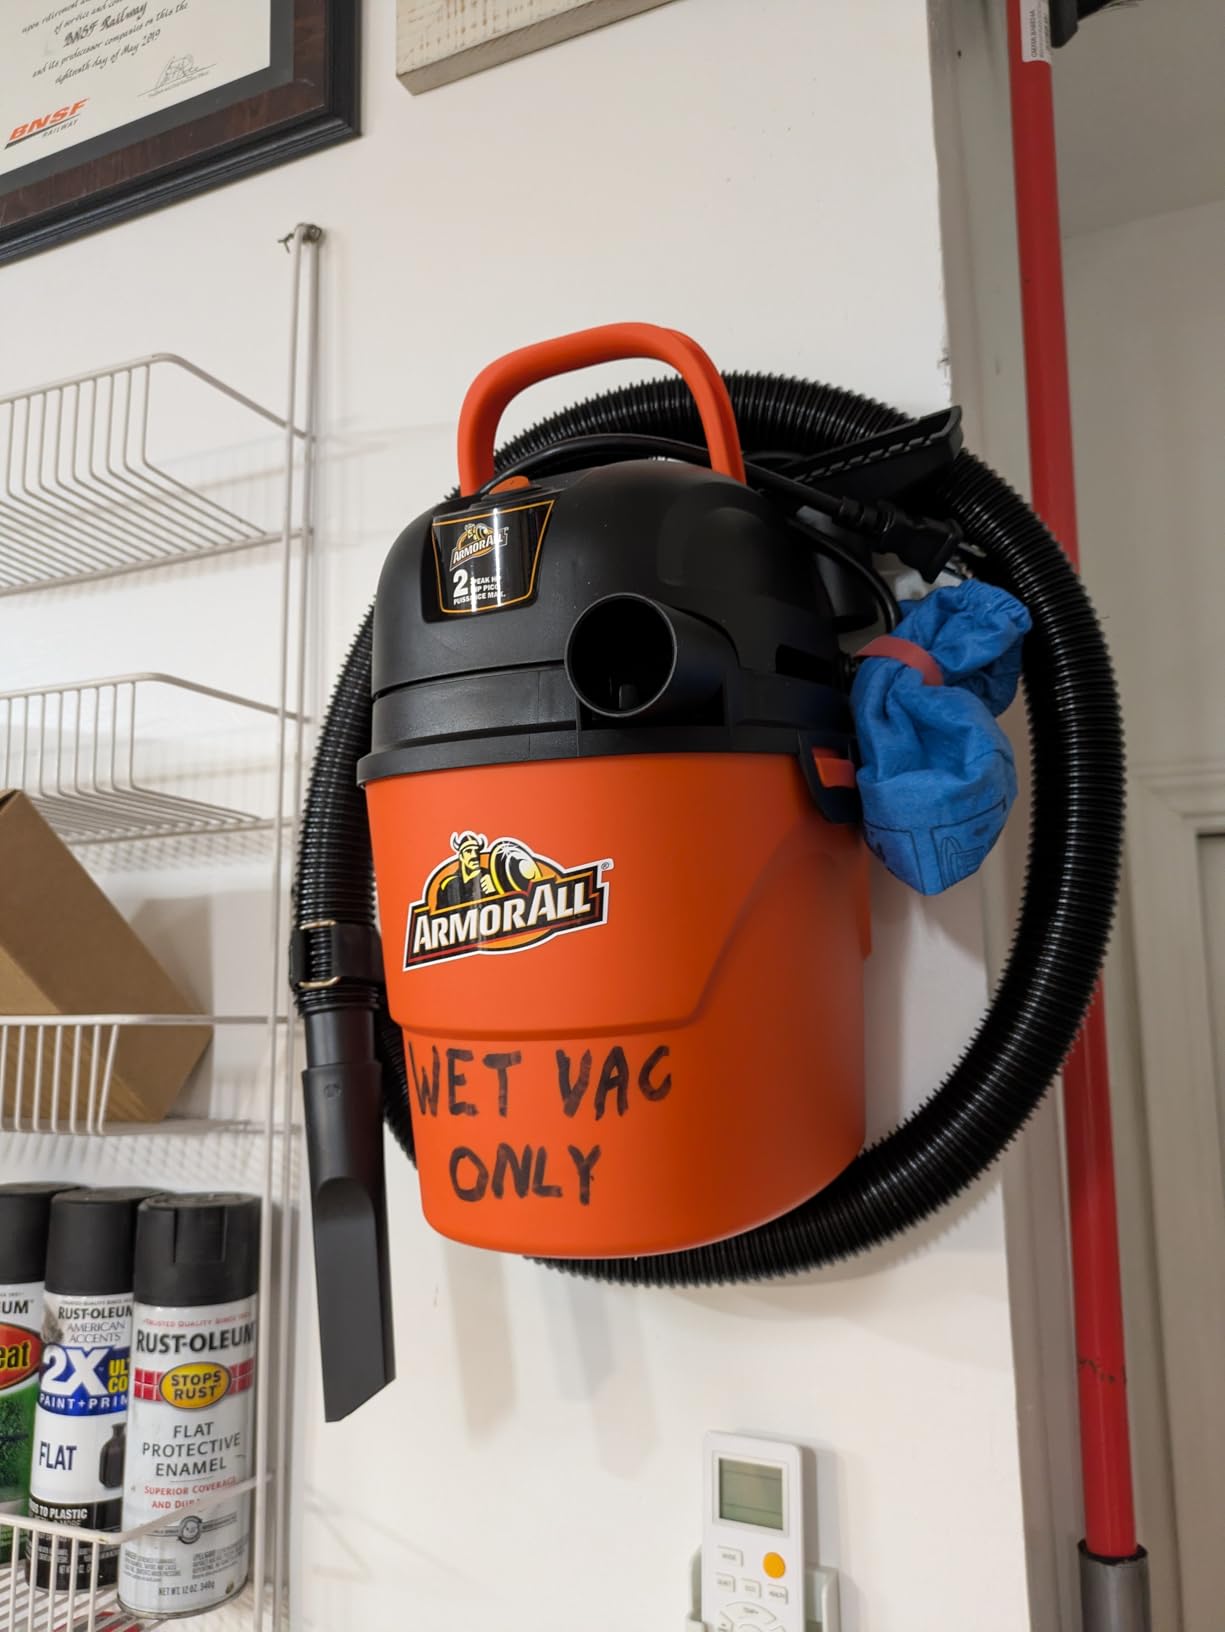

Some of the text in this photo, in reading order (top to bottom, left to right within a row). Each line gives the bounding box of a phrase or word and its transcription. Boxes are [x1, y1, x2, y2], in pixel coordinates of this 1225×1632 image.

[99, 1, 147, 32] Railway
[9, 97, 90, 141] BNSF
[43, 119, 78, 138] RAILWAY
[452, 534, 503, 564] ARMORAL
[453, 569, 469, 598] 2
[453, 593, 487, 605] PUISSCE
[408, 1041, 672, 1121] WET VAC
[449, 1142, 602, 1205] ONLY
[67, 1320, 125, 1333] AMERICAN
[70, 1332, 121, 1345] ACCENTS
[41, 1344, 110, 1396] 2X
[171, 1370, 222, 1386] STOPS
[174, 1385, 218, 1400] RUST
[173, 1421, 214, 1438] FLAT
[142, 1432, 241, 1458] PROTECTIVE
[39, 1440, 77, 1471] FLAT
[155, 1456, 227, 1477] ENAMEL
[144, 1485, 189, 1496] SUPERIOR
[40, 1505, 49, 1518] TO
[49, 1508, 88, 1520] PLASTIC
[152, 1500, 172, 1509] AND
